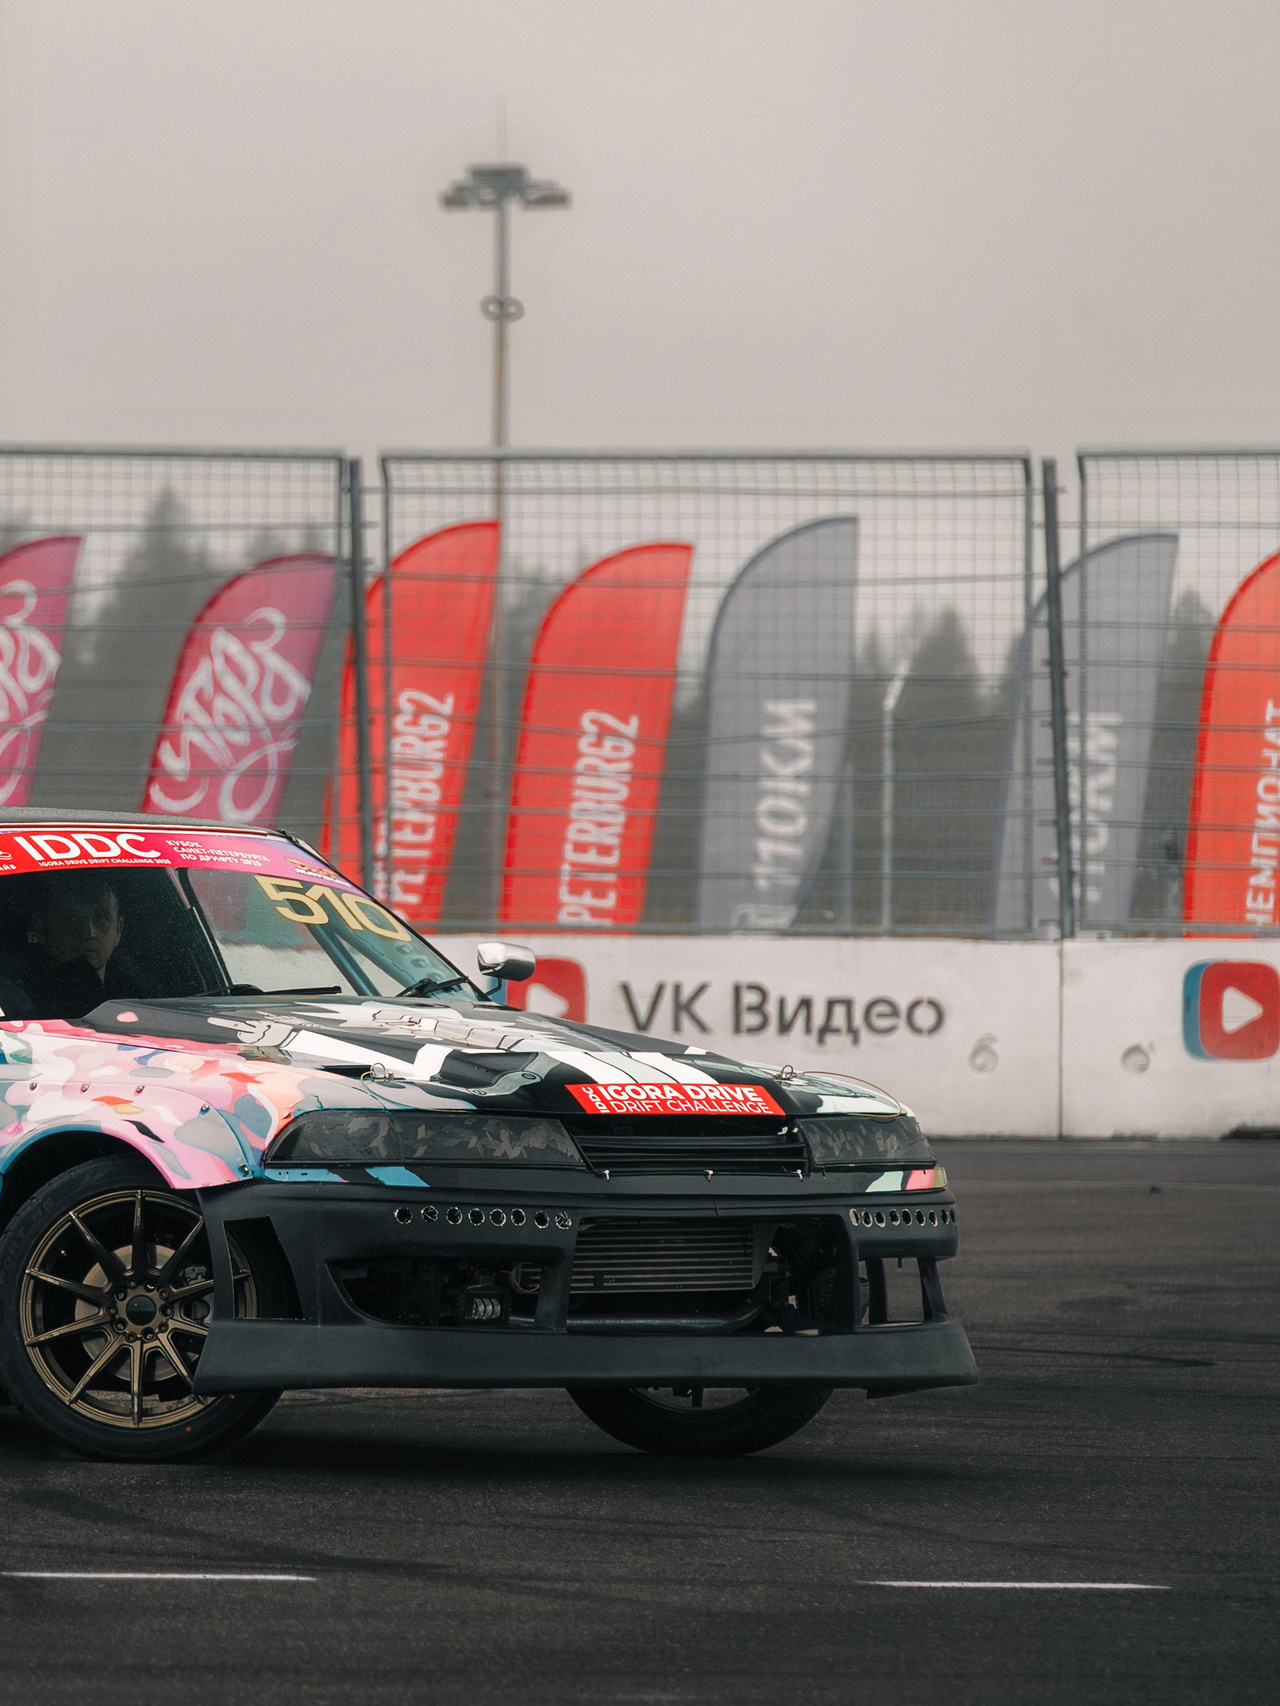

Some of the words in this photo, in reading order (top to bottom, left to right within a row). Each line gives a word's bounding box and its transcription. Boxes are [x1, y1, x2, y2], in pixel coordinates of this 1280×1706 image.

[557, 708, 639, 928] PETERBURG2
[13, 833, 162, 861] IDDC
[173, 846, 270, 862] САНКТ-ПЕТЕРБУРГА
[180, 853, 198, 861] ПО
[199, 854, 240, 865] ДРИФТУ
[254, 874, 413, 942] 510
[620, 980, 715, 1035] VK
[733, 981, 946, 1046] Видео
[582, 1086, 610, 1113] IDDC
[597, 1085, 680, 1101] IGORA
[681, 1086, 764, 1102] DRIVE
[609, 1100, 664, 1113] DRIFT
[666, 1100, 773, 1114] CHALLENGE
